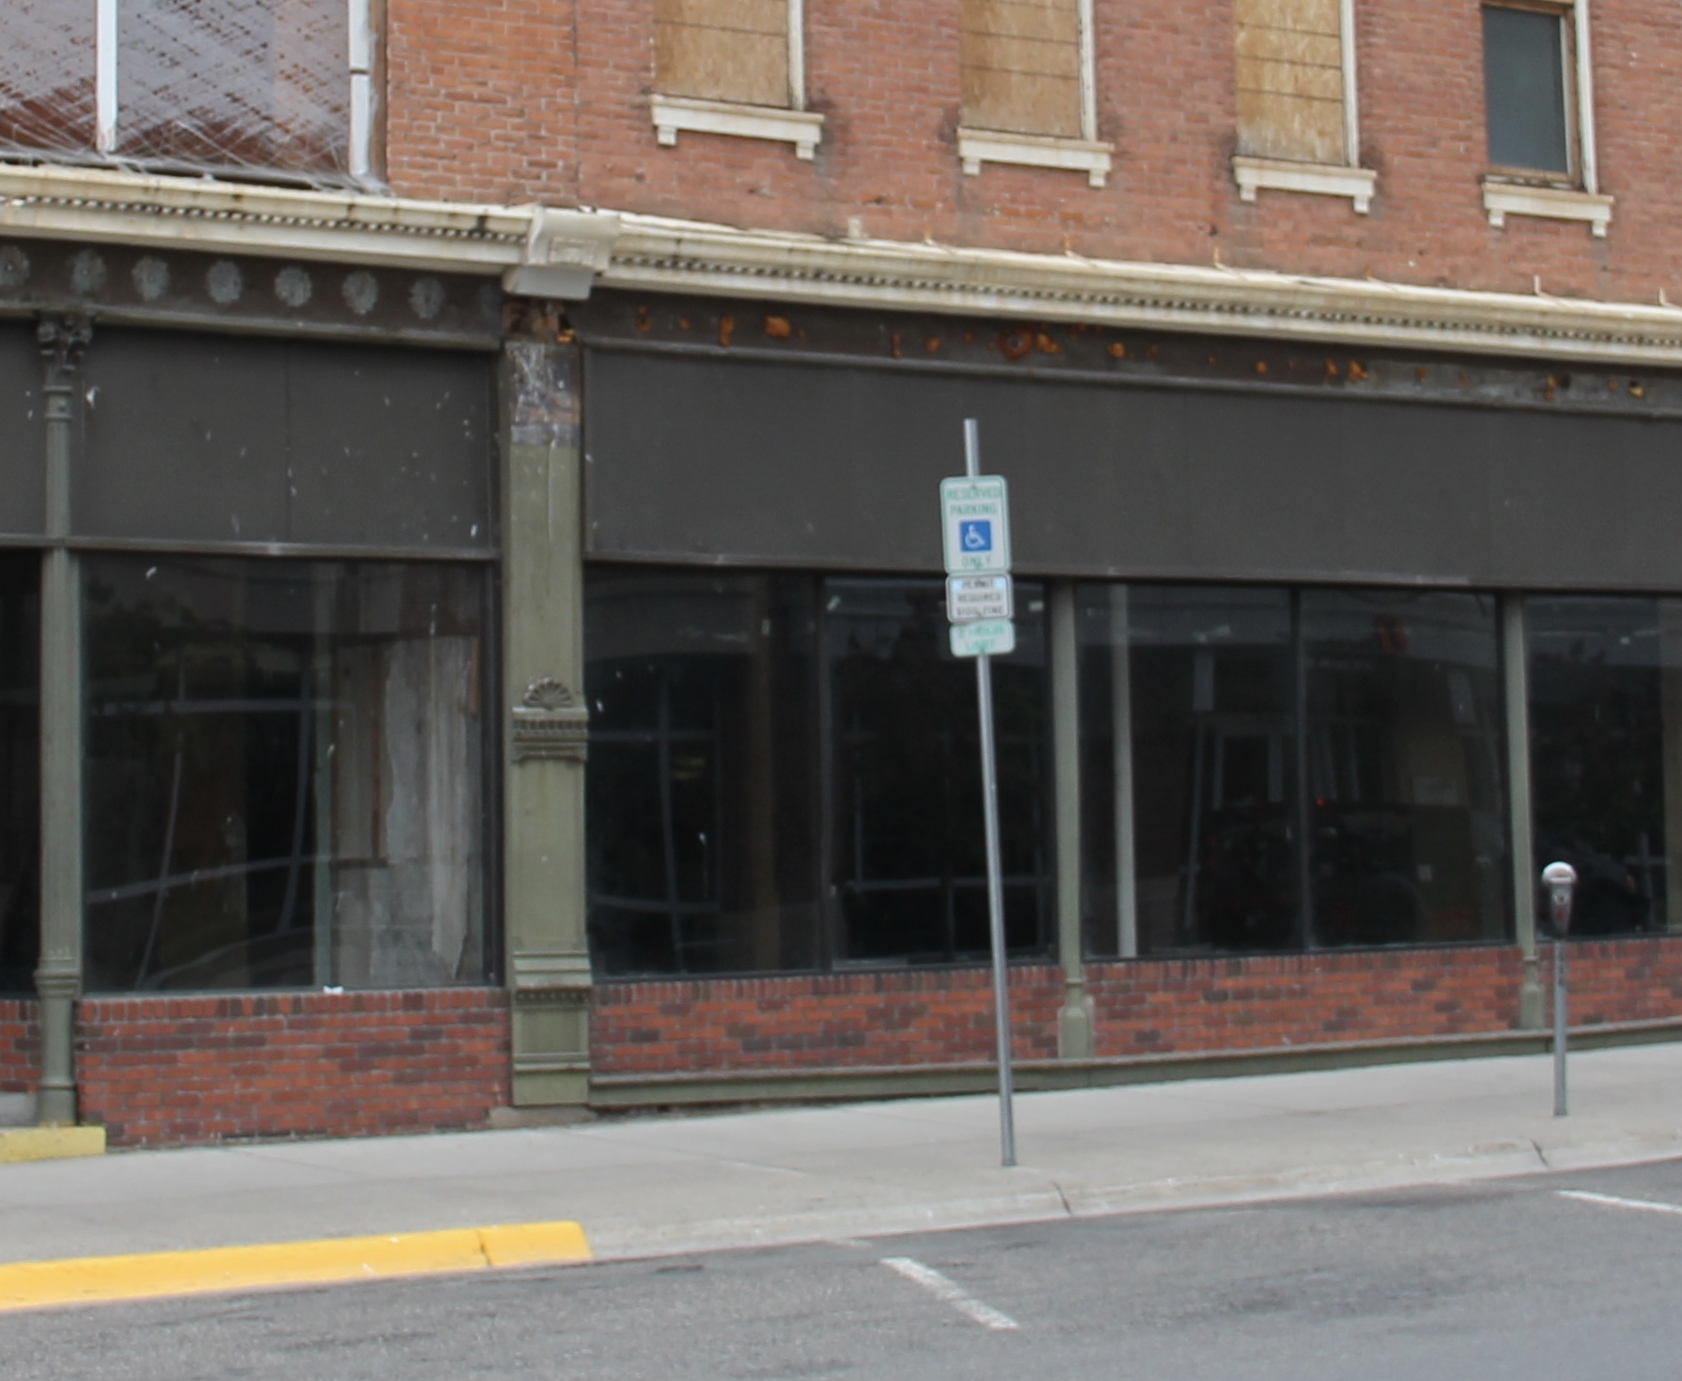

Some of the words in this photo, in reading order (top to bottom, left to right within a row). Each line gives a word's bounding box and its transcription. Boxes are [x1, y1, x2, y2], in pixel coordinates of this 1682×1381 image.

[946, 487, 1001, 500] RESERVED
[949, 503, 997, 516] PARKING
[961, 555, 992, 567] ONLY
